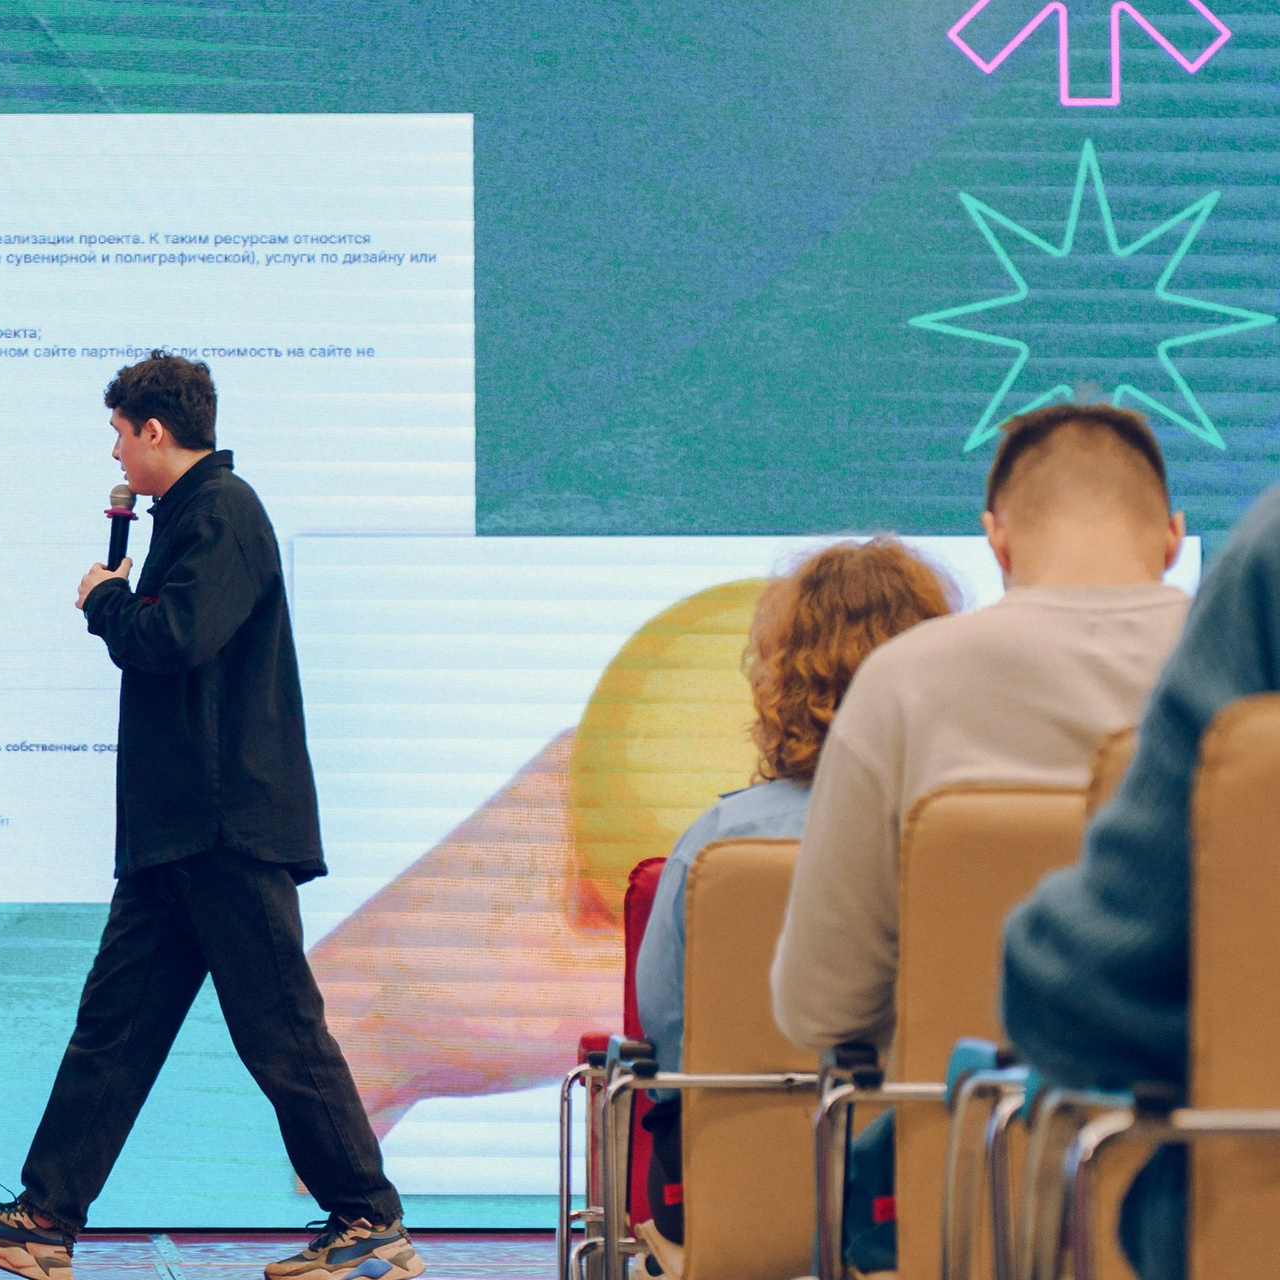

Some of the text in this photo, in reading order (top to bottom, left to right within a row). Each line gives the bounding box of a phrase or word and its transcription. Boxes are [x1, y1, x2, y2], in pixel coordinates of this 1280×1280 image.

[148, 231, 160, 245] К
[163, 234, 211, 245] таким
[213, 234, 290, 248] ресурсам
[292, 234, 372, 245] относится
[5, 250, 97, 267] сувенирной
[101, 253, 111, 264] и
[264, 253, 316, 267] услуги
[320, 253, 339, 264] по
[342, 250, 406, 267] дизайну
[409, 253, 438, 264] или
[33, 344, 77, 358] сайте
[201, 347, 283, 358] стоимость
[286, 347, 306, 358] на
[309, 344, 352, 358] сайте
[355, 347, 376, 358] не
[5, 740, 89, 753] собственные
